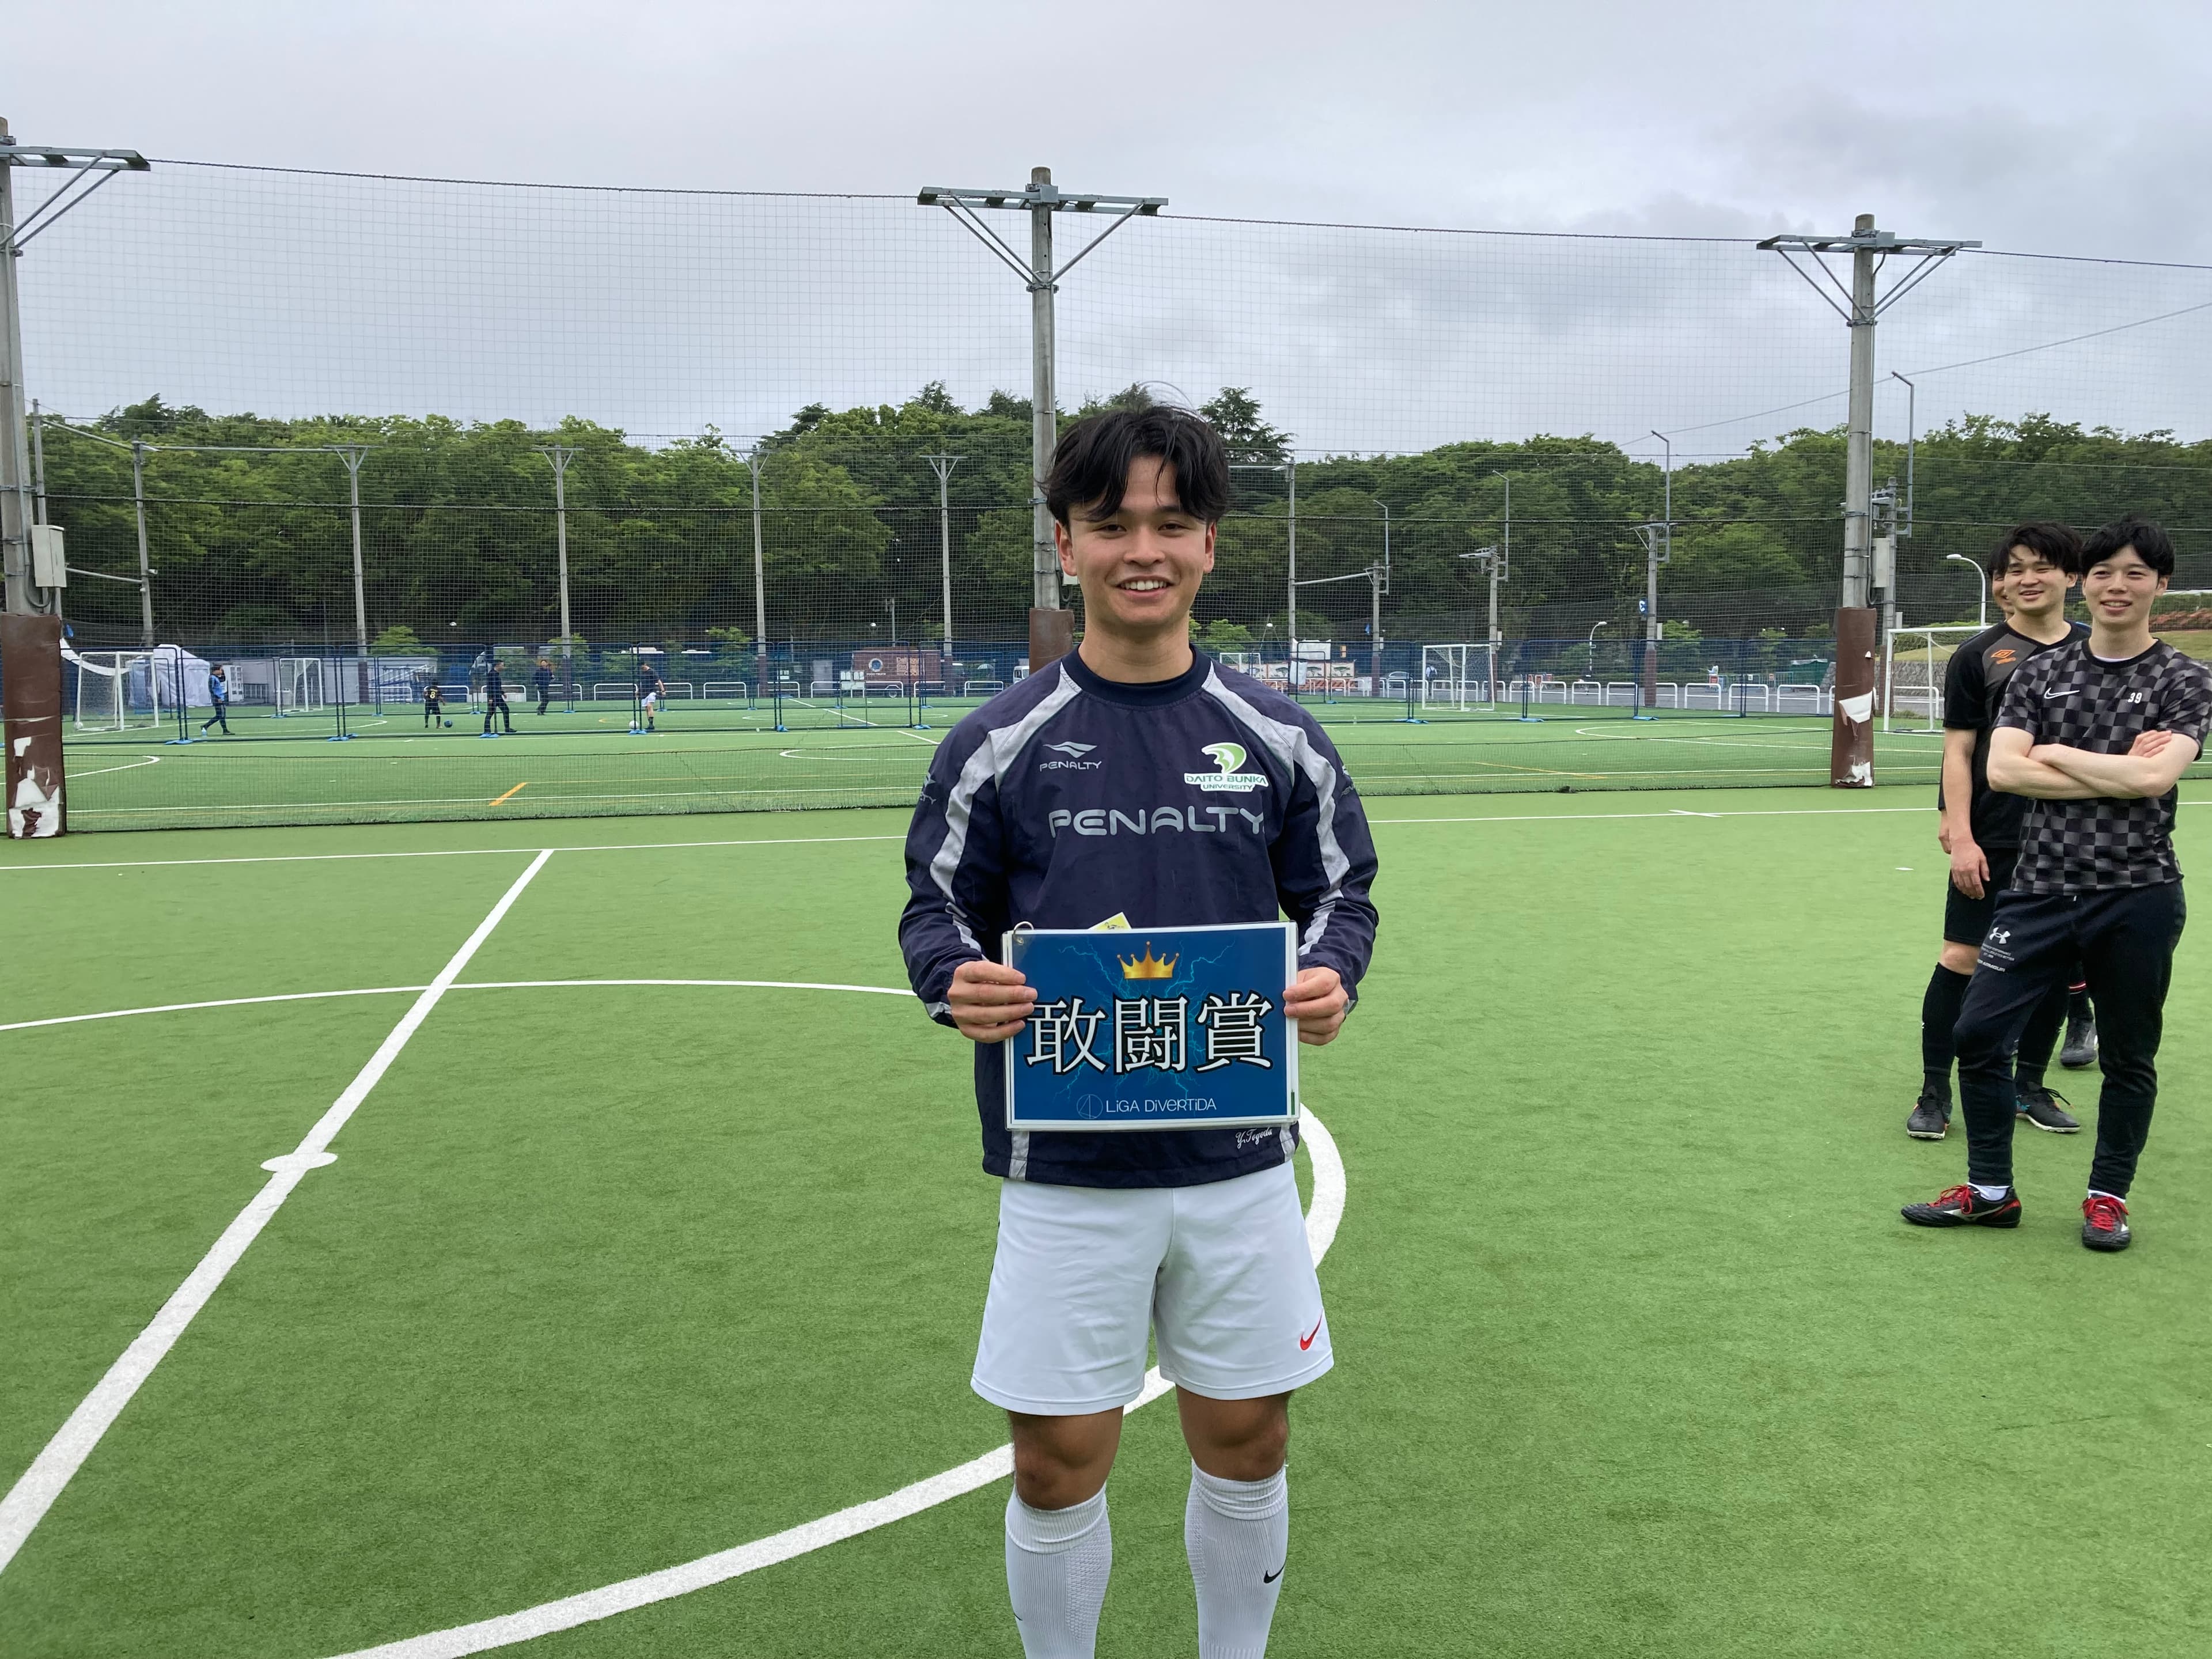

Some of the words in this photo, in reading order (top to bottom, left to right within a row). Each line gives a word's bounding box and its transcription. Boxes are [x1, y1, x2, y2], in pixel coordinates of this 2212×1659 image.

[2127, 692, 2142, 704] 39
[1039, 760, 1102, 772] PENALTY
[1186, 775, 1223, 783] DAITO
[1226, 775, 1267, 785] BUNKA
[1048, 805, 1264, 839] PENALTY
[1026, 991, 1273, 1074] 敢闘賞
